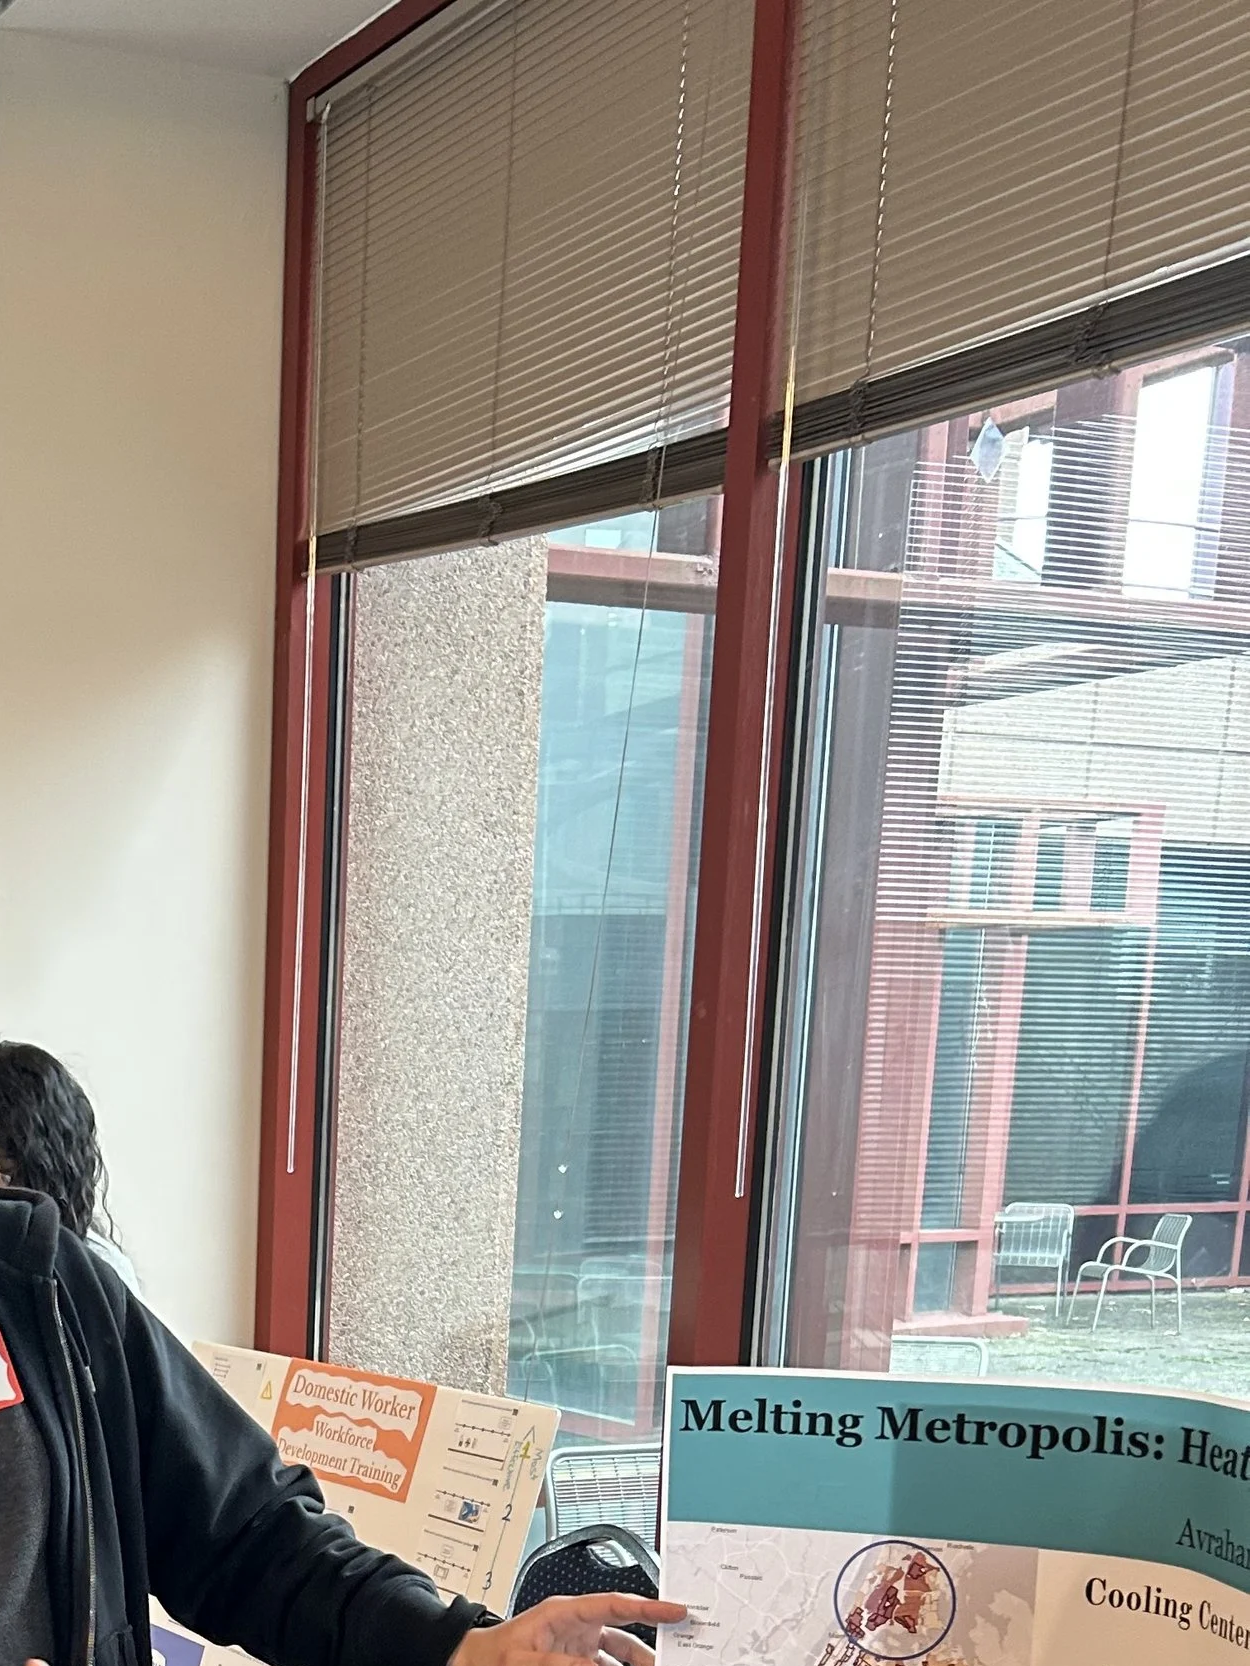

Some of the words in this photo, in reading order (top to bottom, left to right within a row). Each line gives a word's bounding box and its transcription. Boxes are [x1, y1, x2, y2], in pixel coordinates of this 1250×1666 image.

[293, 1374, 357, 1407] Domestic
[361, 1389, 415, 1420] Worker
[315, 1420, 373, 1450] Workforce
[679, 1398, 864, 1448] Melting
[875, 1405, 1165, 1460] Metropolis:
[1177, 1426, 1250, 1481] Heat
[278, 1438, 347, 1472] Development
[350, 1457, 401, 1490] Training
[502, 1504, 513, 1522] 2
[1175, 1517, 1250, 1570] Avraha
[482, 1571, 493, 1591] 3
[1085, 1577, 1192, 1631] Cooling
